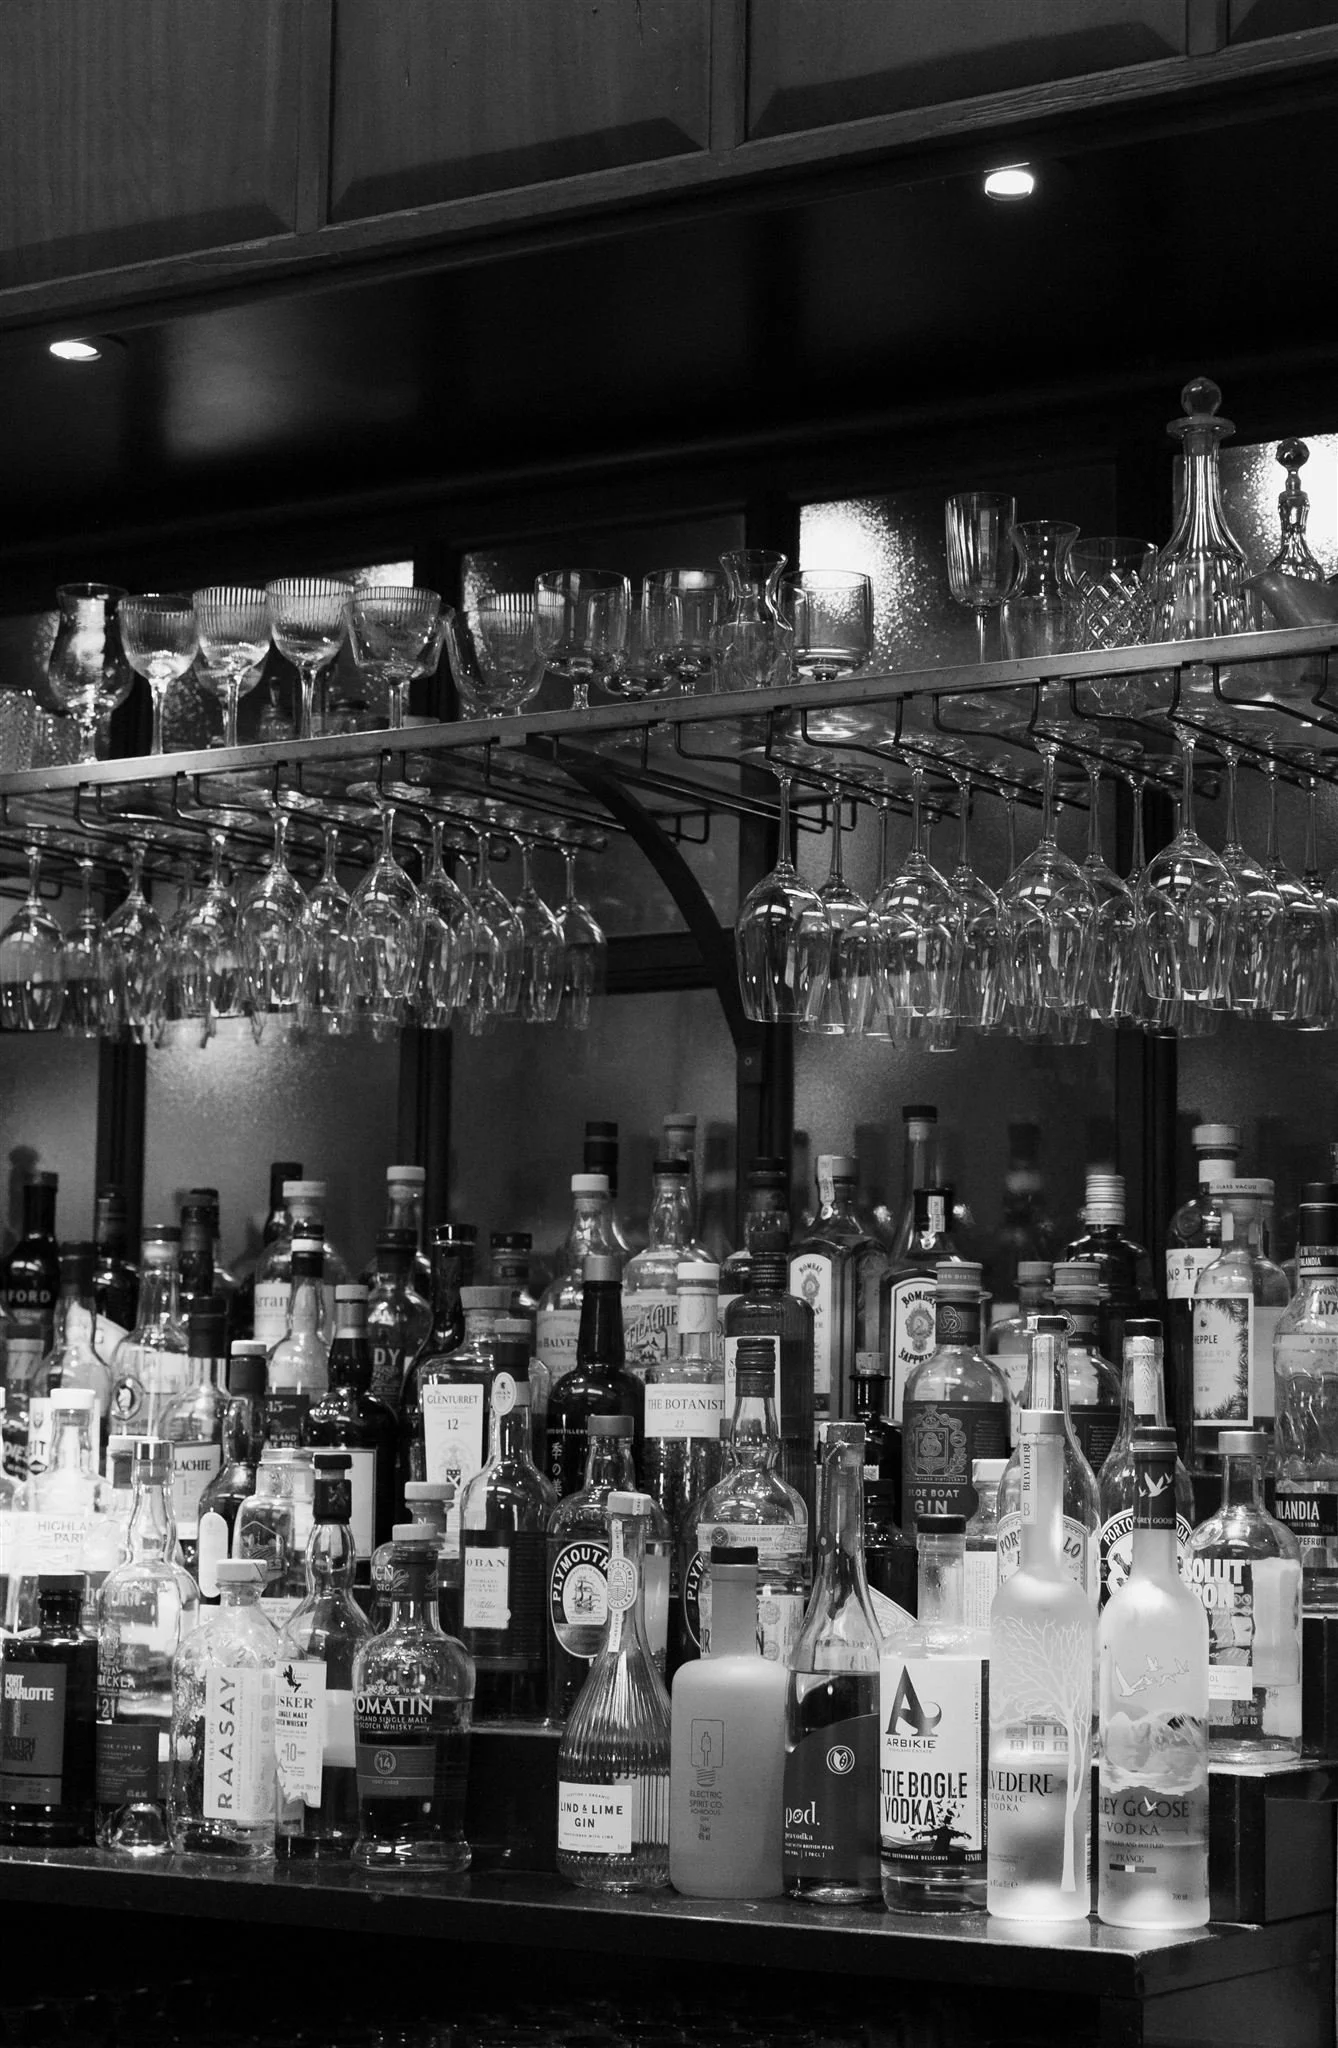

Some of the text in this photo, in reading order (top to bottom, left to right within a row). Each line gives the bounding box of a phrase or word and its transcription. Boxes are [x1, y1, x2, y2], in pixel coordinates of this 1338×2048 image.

[426, 1394, 478, 1404] GLENTURRET
[648, 1399, 724, 1410] THE BOTANIST
[447, 1419, 458, 1430] 12
[930, 1489, 960, 1498] BOAT
[914, 1500, 948, 1514] GIN
[466, 1558, 506, 1568] OBAN
[553, 1548, 608, 1602] PLYMOUTH
[5, 1674, 24, 1687] PORT
[4, 1686, 54, 1701] CHARLOTTE
[101, 1698, 116, 1718] 21
[218, 1677, 236, 1809] RAASAY
[886, 1738, 936, 1748] ARBIKIE
[286, 1742, 297, 1762] 10
[908, 1772, 968, 1798] BOGLE
[690, 1790, 722, 1800] ELECTRIC
[560, 1802, 579, 1813] LIND
[592, 1804, 624, 1815] LIME
[884, 1796, 936, 1826] VODKA
[1123, 1797, 1190, 1818] GOOSE
[574, 1818, 595, 1828] GIN
[1106, 1821, 1160, 1836] VODKA
